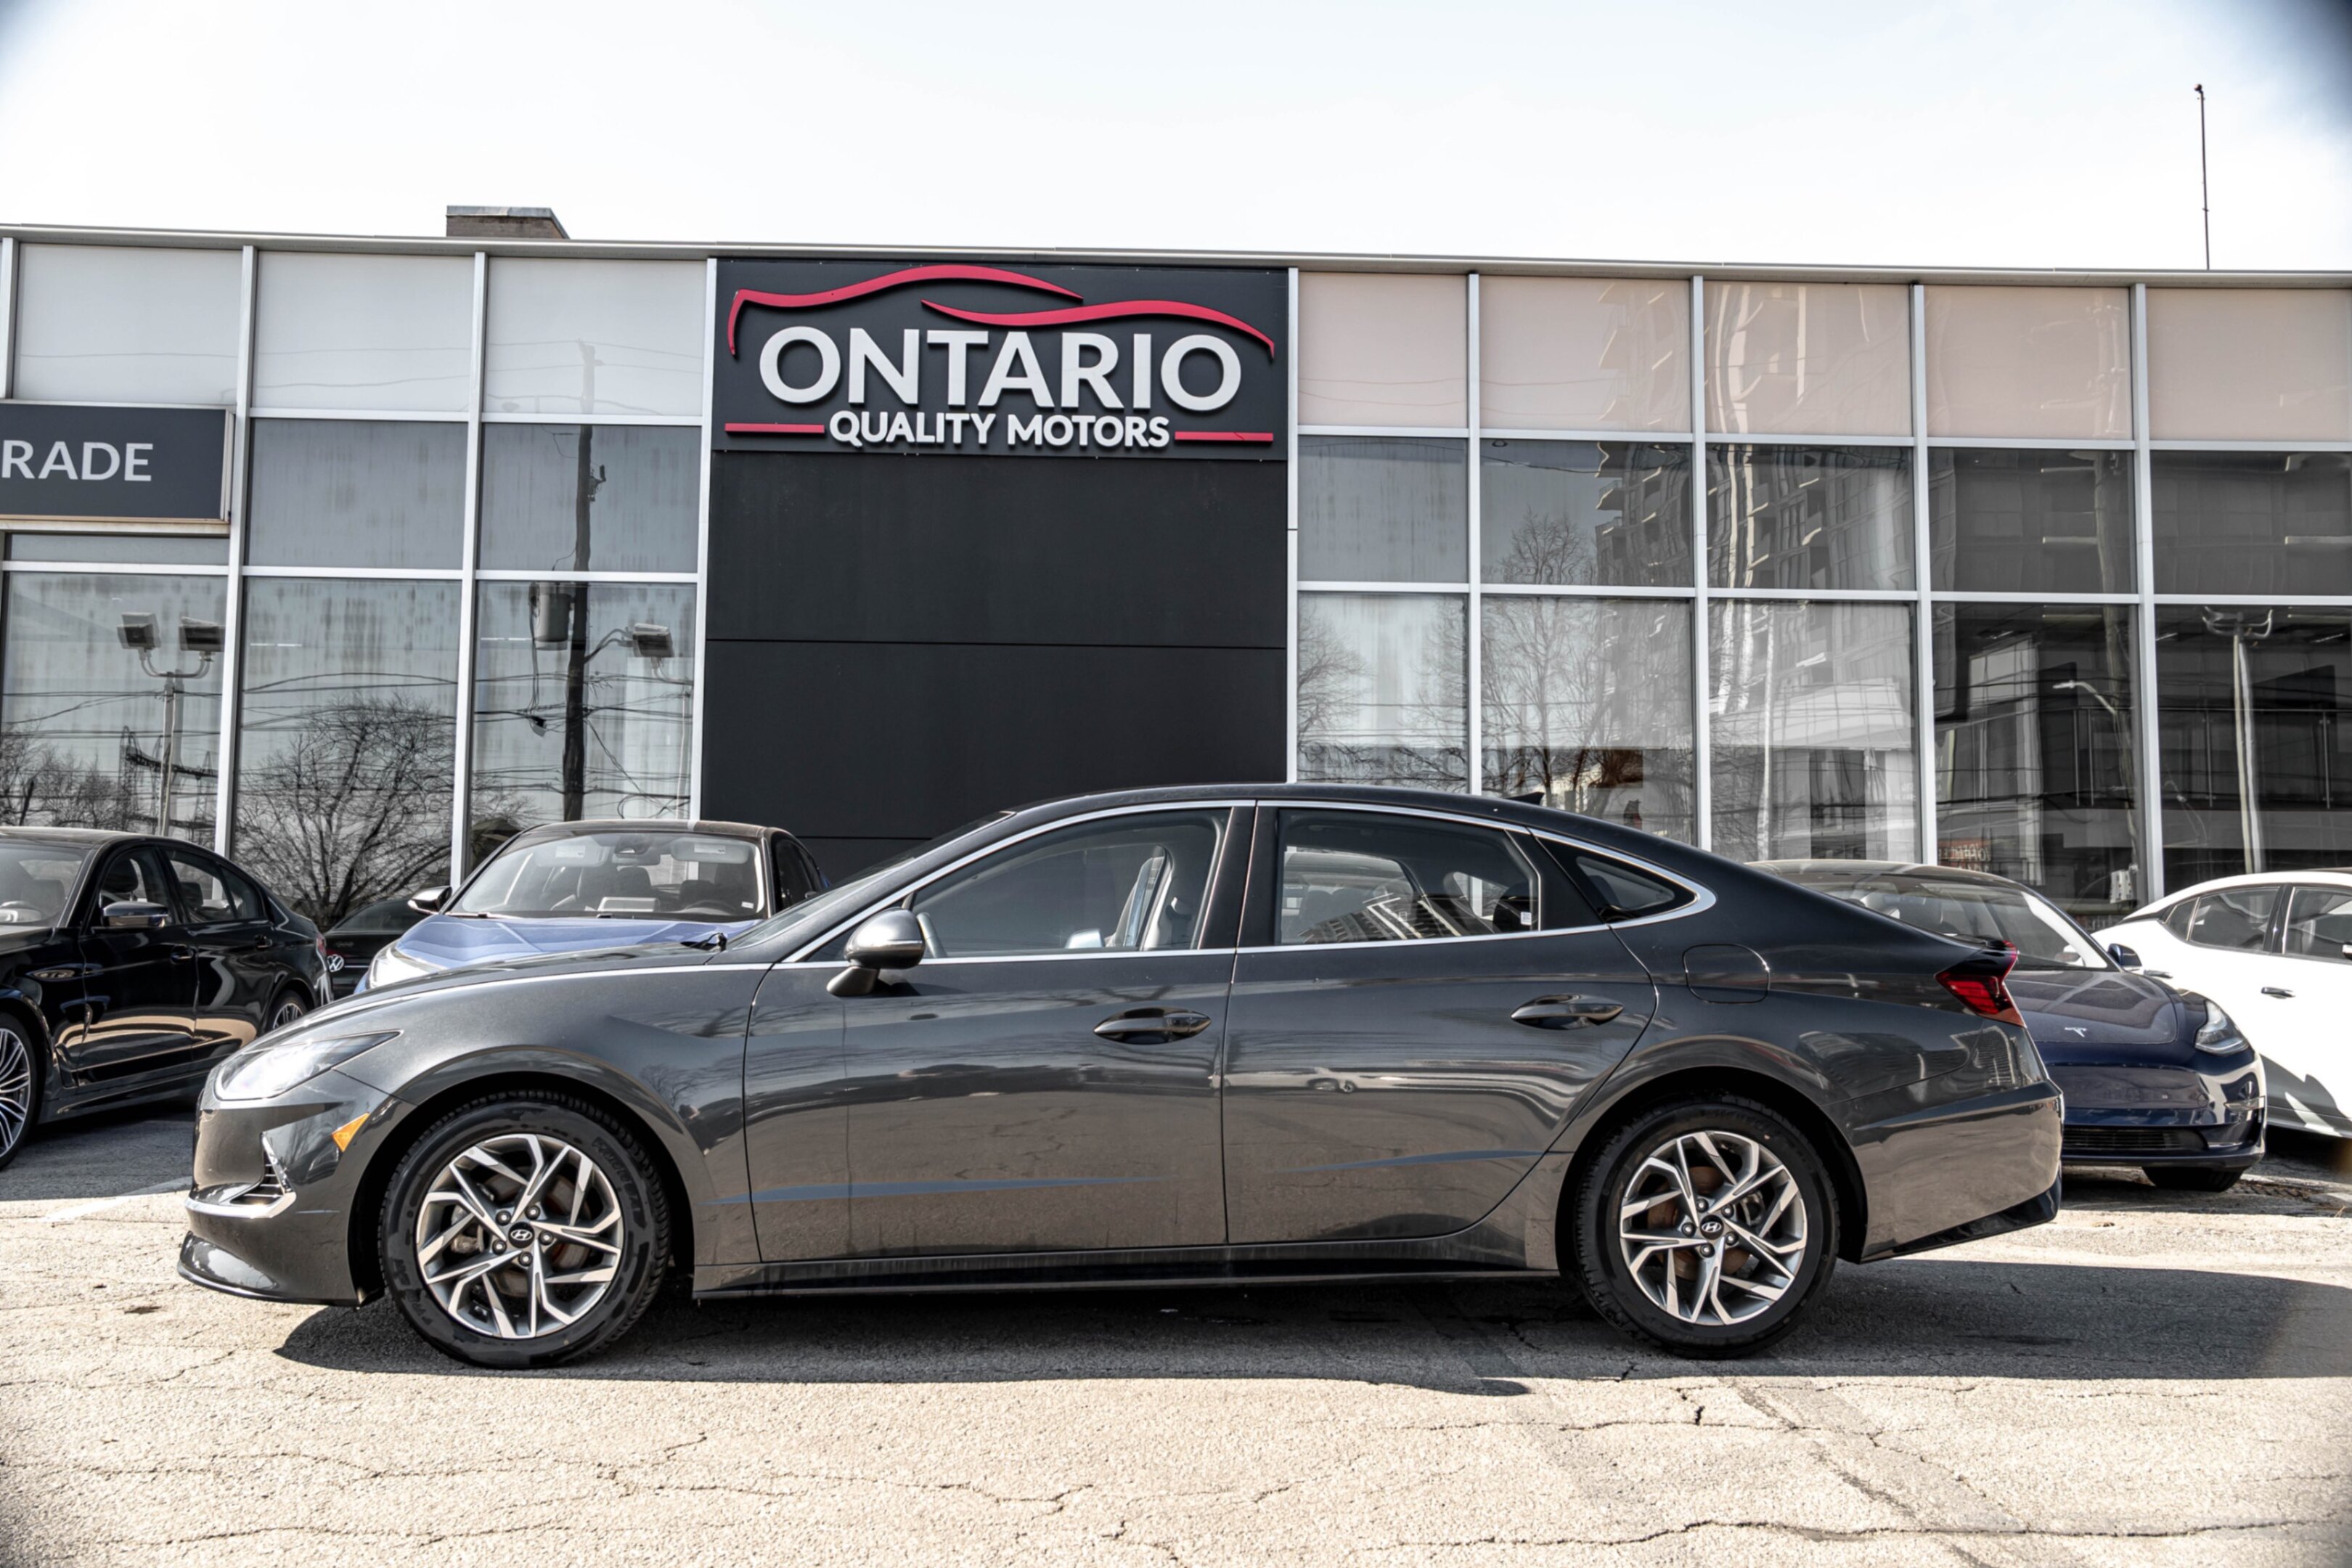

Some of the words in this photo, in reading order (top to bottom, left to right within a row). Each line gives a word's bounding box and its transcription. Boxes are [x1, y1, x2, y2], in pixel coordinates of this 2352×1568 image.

[759, 326, 1241, 411] ONTARIO
[829, 410, 996, 447] QUALITY
[1007, 414, 1170, 447] MOTORS
[1, 440, 154, 481] RADE
